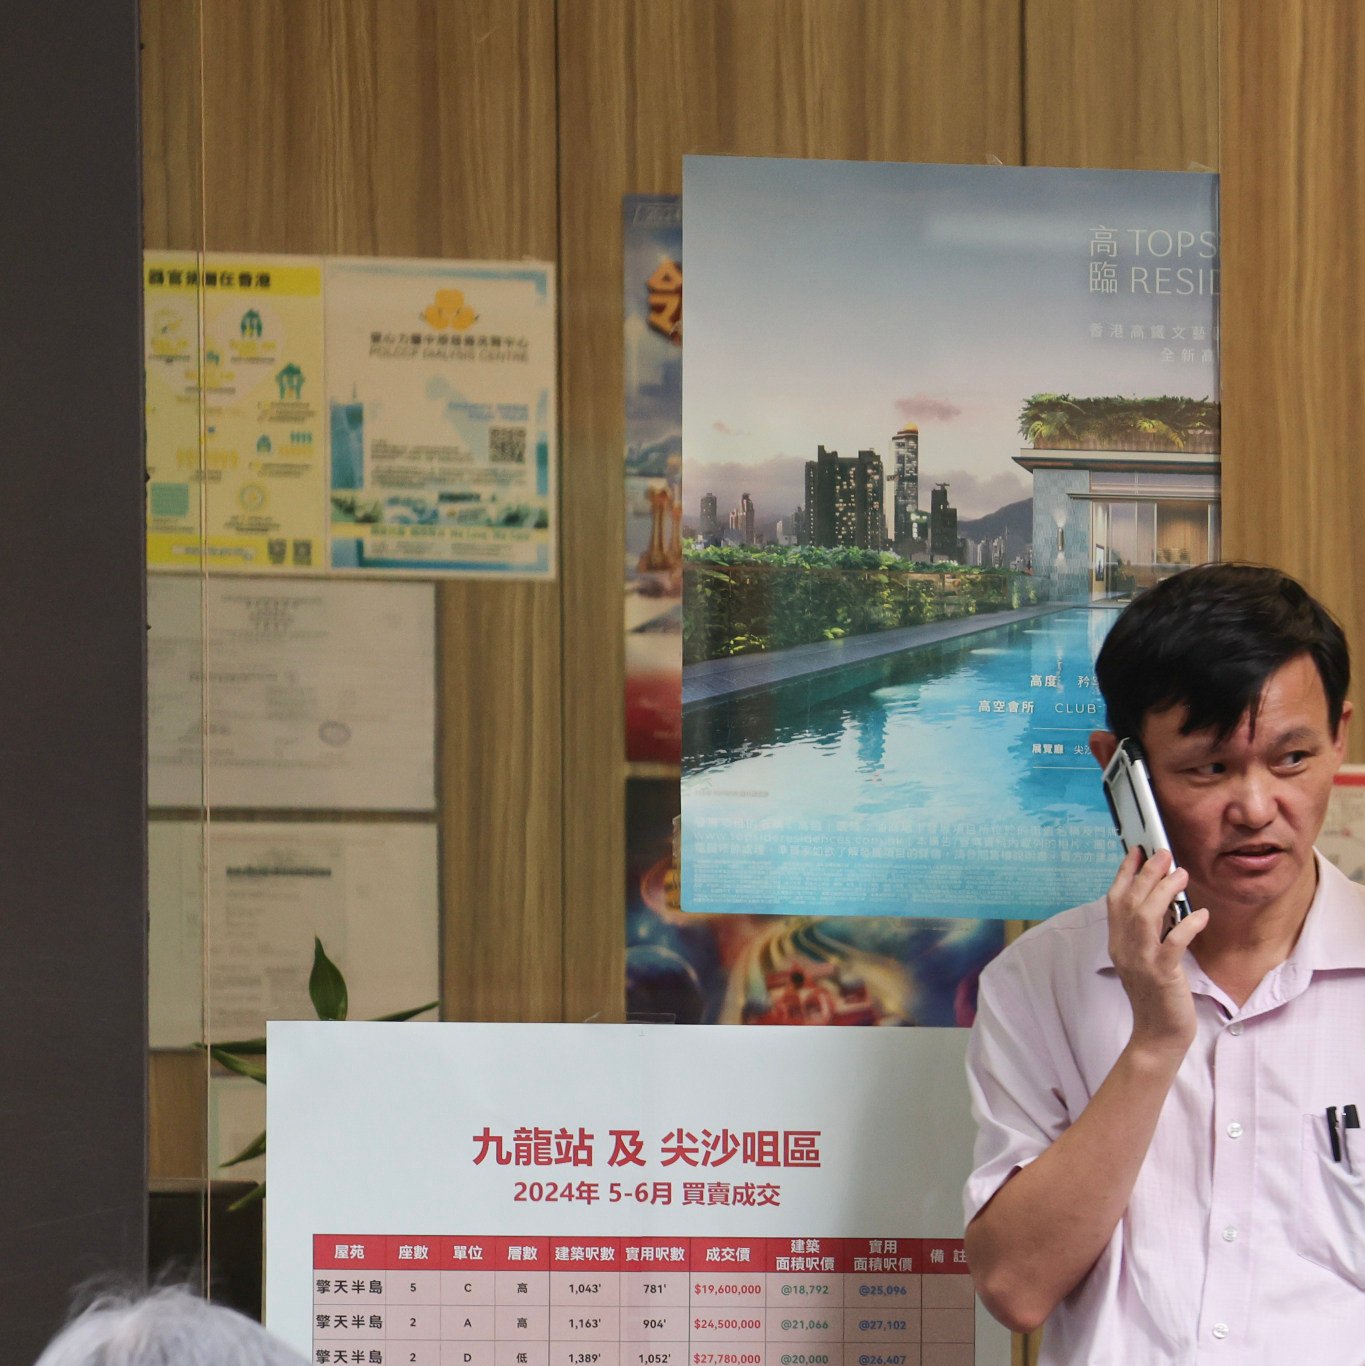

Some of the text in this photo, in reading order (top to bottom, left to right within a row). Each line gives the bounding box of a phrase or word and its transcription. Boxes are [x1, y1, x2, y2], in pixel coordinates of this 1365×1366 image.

[1030, 674, 1058, 688] 高度
[978, 699, 1097, 714] 高空會所 CLUB
[472, 1126, 822, 1170] 九龍站 及 尖沙咀區
[513, 1180, 782, 1208] 2024年 5-6月 買賣成交
[334, 1244, 365, 1260] 屋苑
[398, 1244, 429, 1260] 座數
[452, 1245, 483, 1261] 單位
[507, 1245, 538, 1261] 層數
[554, 1246, 615, 1262] 建築呎數
[625, 1246, 685, 1262] 實用呎數
[705, 1246, 751, 1262] 成交價
[790, 1239, 897, 1254] 建築 實用
[776, 1256, 913, 1272] 面積呎價 面積呎價
[411, 1283, 416, 1292] 5
[464, 1283, 472, 1292] C
[517, 1283, 528, 1293] 高
[695, 1283, 761, 1295] $19,600,000
[410, 1318, 416, 1327] 2
[464, 1318, 472, 1327] A
[517, 1317, 527, 1328] 高
[694, 1318, 760, 1330] $24,500,000
